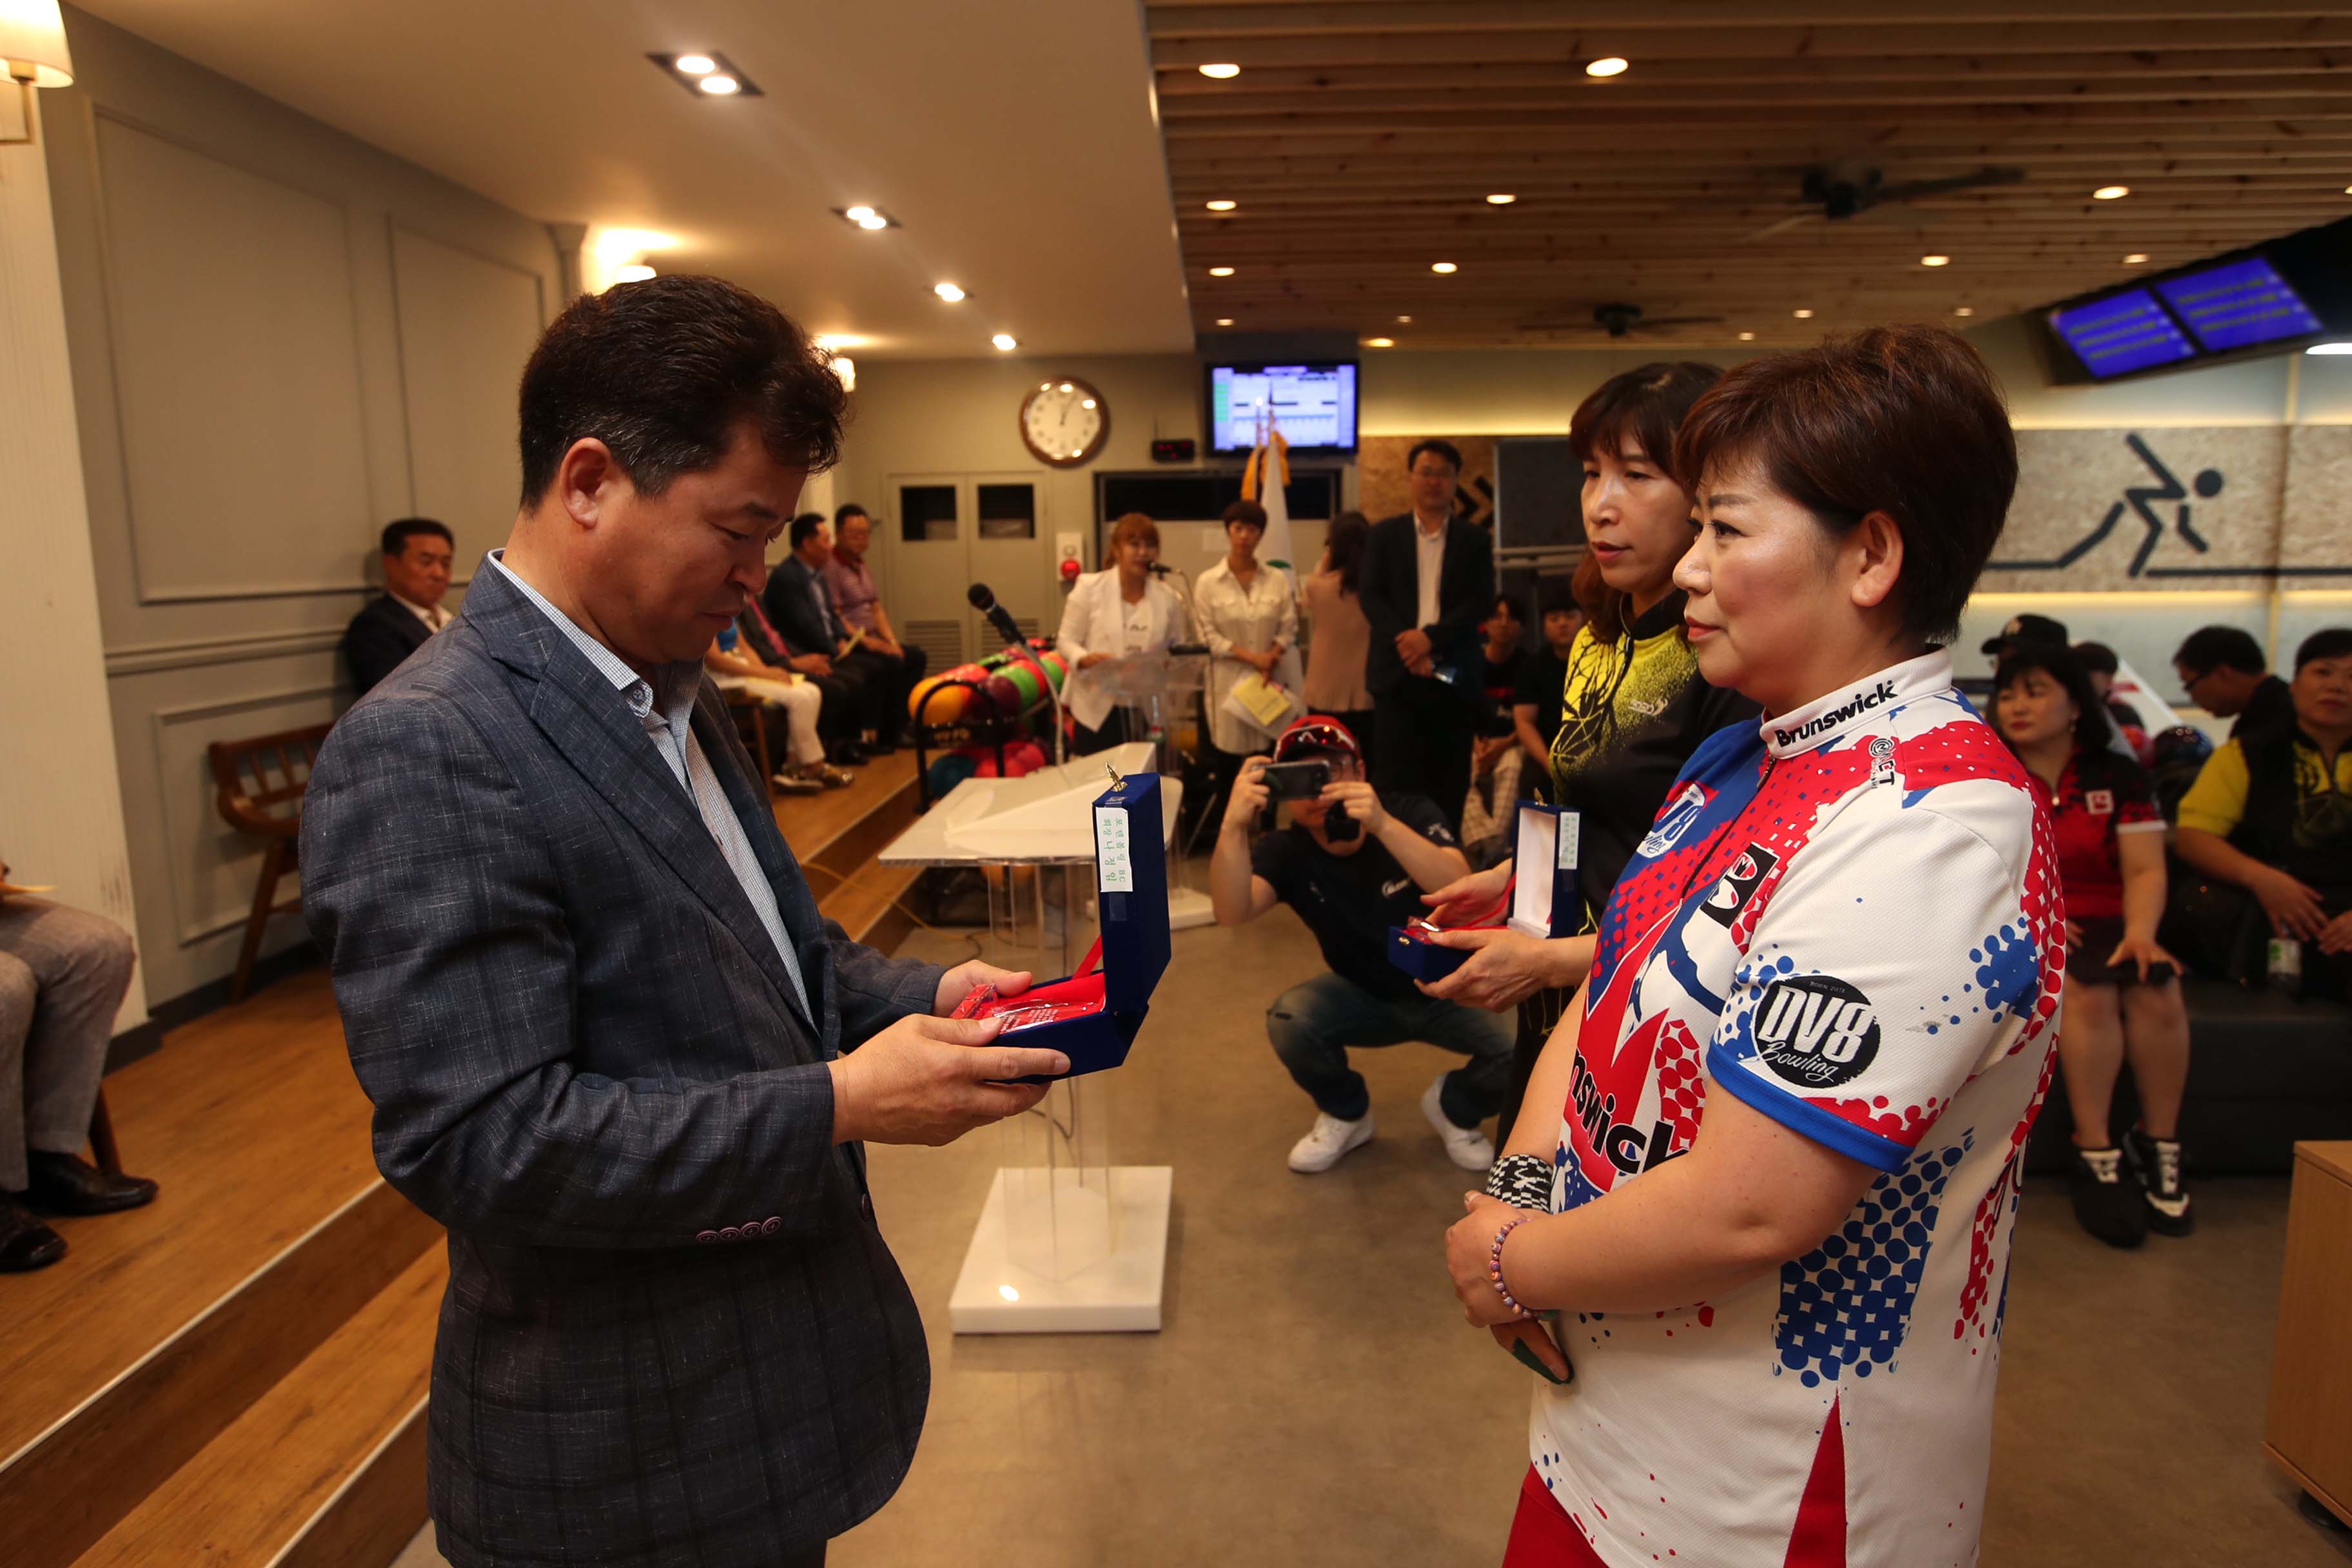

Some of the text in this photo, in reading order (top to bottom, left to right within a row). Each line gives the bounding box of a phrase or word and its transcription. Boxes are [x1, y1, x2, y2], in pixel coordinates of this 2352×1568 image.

[1774, 680, 1898, 747] Brunswick
[1758, 985, 1872, 1063] DV8
[1761, 1041, 1839, 1083] Bowling
